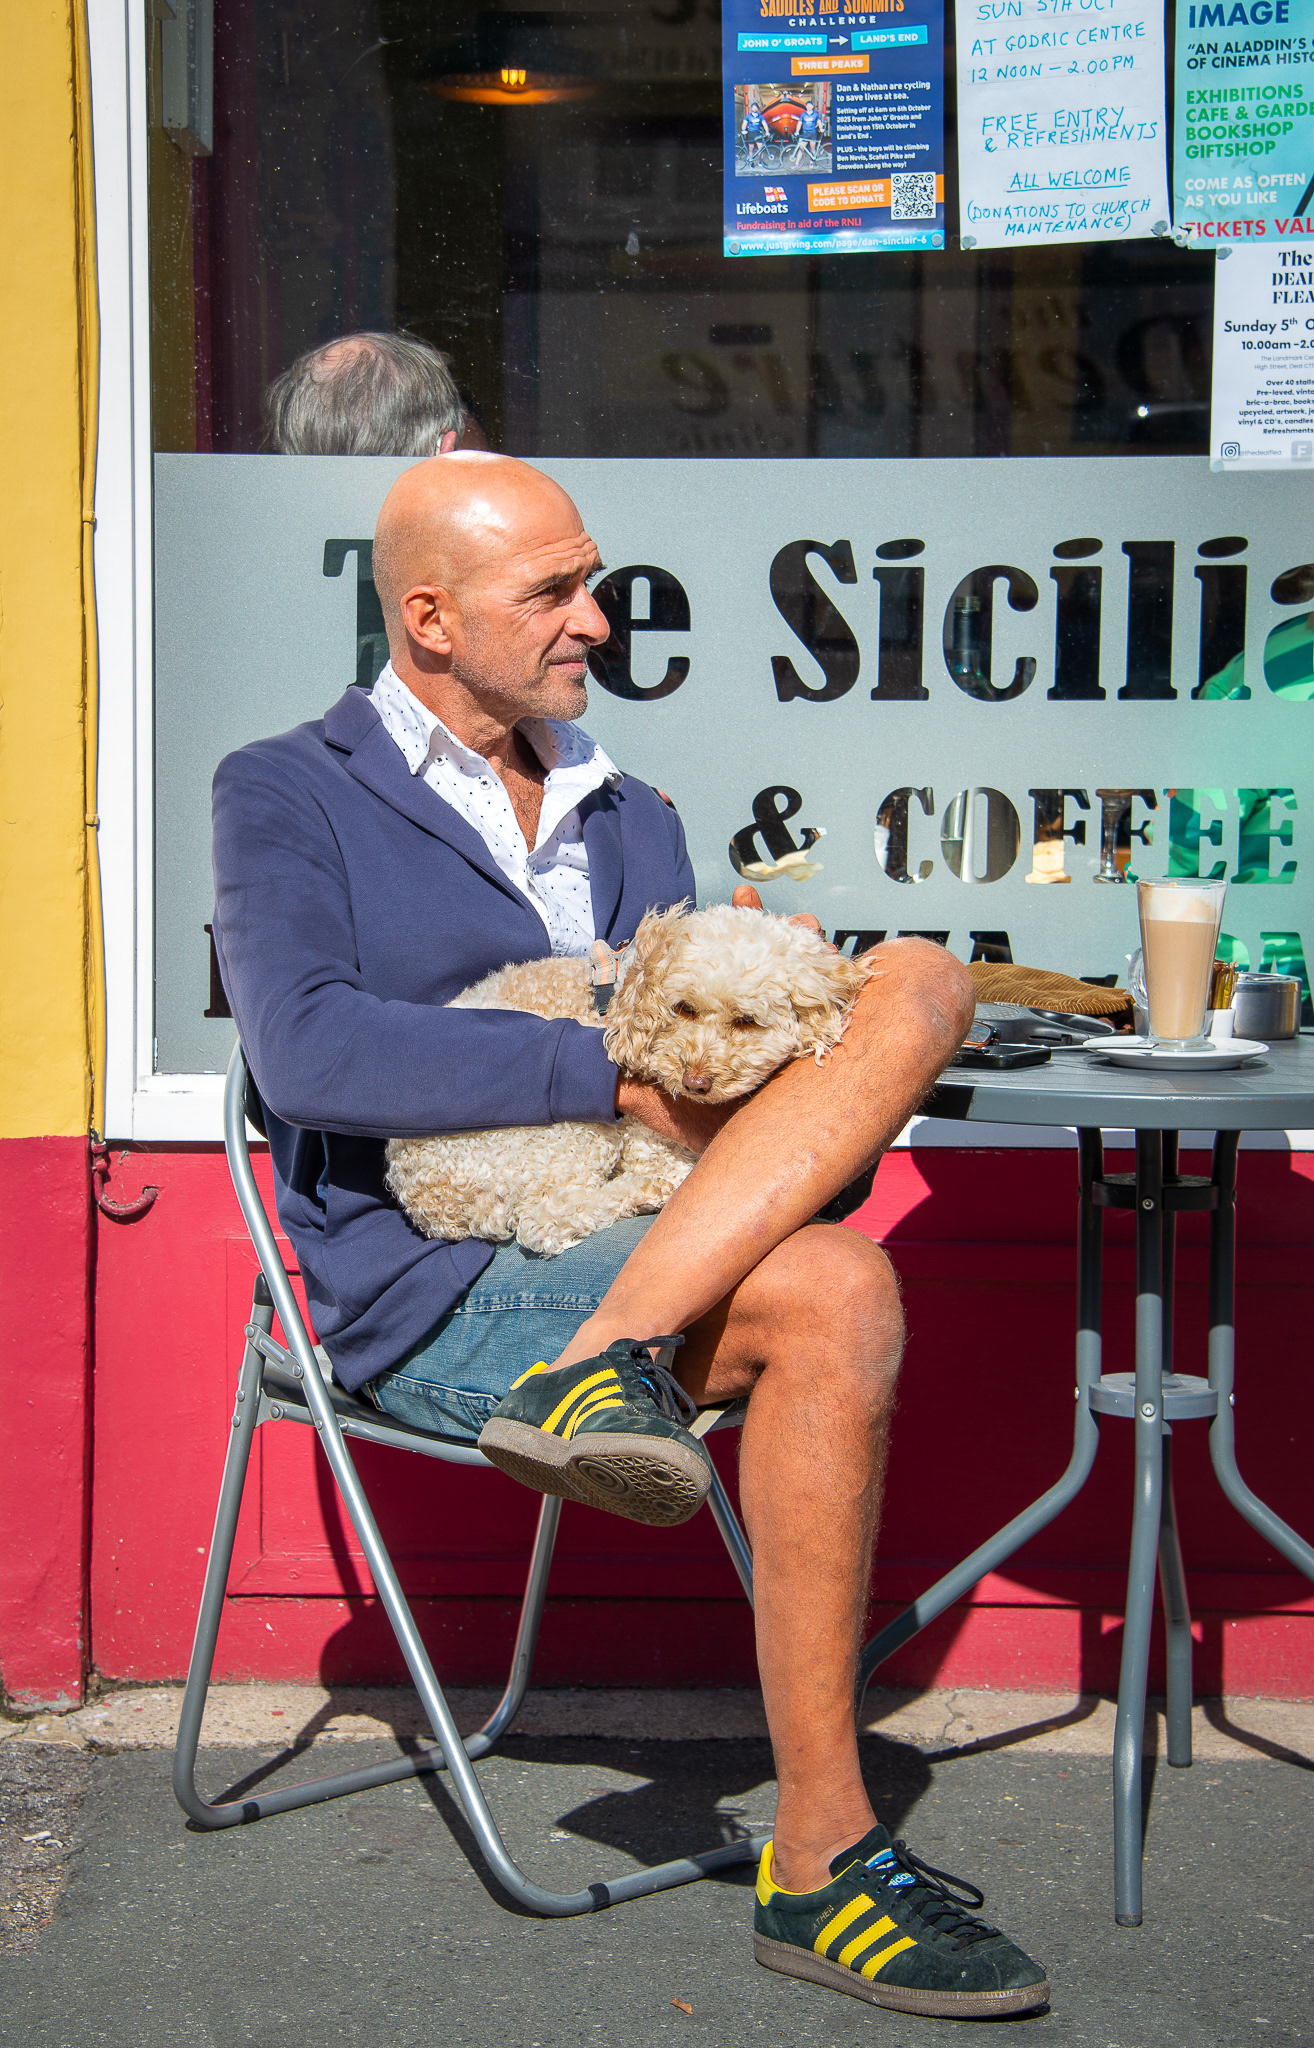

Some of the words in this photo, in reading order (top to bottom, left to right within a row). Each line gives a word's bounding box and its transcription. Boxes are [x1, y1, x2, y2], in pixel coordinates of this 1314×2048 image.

[760, 0, 815, 17] SADDLES
[819, 0, 839, 15] AND
[843, 0, 904, 15] SUMMITS
[977, 0, 1021, 20] SUN
[1189, 0, 1289, 28] IMAGE
[789, 16, 877, 27] CHALLENGE
[742, 39, 769, 48] JOHN
[784, 37, 823, 46] GROATS
[898, 33, 918, 42] END
[972, 39, 997, 56] AT
[1006, 32, 1069, 51] GODRIC
[1077, 22, 1146, 45] CENTRE
[798, 61, 829, 70] THREE
[832, 59, 863, 69] PEAKS
[1187, 58, 1206, 70] OF
[1211, 54, 1271, 69] CINEMA
[972, 68, 987, 83] 12
[997, 64, 1042, 78] NOON
[837, 84, 852, 92] Dan
[861, 83, 888, 92] Nathan
[904, 81, 931, 91] cycling
[1186, 84, 1304, 104] EXHIBITIONS
[837, 94, 845, 102] to
[865, 93, 883, 101] lives
[884, 92, 892, 100] at
[837, 107, 858, 115] Setting
[1186, 107, 1228, 123] CAFE
[1235, 106, 1249, 120] &
[837, 124, 862, 132] finishing
[983, 113, 1038, 135] FREE
[1055, 107, 1124, 128] ENTRY
[1007, 122, 1158, 148] REFRESHMENTS
[1186, 121, 1293, 141] BOOKSHOP
[868, 145, 883, 153] boys
[904, 143, 929, 151] climbing
[1185, 140, 1276, 159] GIFTSHOP
[864, 162, 881, 170] along
[1010, 173, 1039, 188] ALL
[1049, 166, 1131, 187] WELCOME
[1185, 177, 1228, 190] COME
[1233, 177, 1252, 188] AS
[1257, 173, 1306, 187] OFTEN
[813, 186, 845, 196] PLEASE
[847, 185, 870, 194] SCAN
[813, 197, 835, 207] CODE
[837, 196, 849, 205] TO
[850, 194, 884, 204] DONATE
[1184, 195, 1204, 207] AS
[1208, 193, 1241, 206] YOU
[1247, 191, 1277, 204] LIKE
[737, 203, 788, 215] Lifeboats
[1066, 203, 1085, 218] TO
[1092, 199, 1151, 215] CHURCH
[737, 220, 786, 231] Fundraising
[788, 220, 796, 228] in
[798, 219, 811, 228] aid
[813, 218, 823, 227] of
[825, 218, 840, 227] the
[841, 217, 862, 226] RNLI
[1005, 215, 1131, 236] MAINTENANCE)
[740, 235, 926, 251] www.justgiving.com/page/dan-sinclair-6
[1278, 250, 1313, 266] The
[1224, 319, 1277, 335] Sunday
[1281, 317, 1298, 331] 5th
[1242, 341, 1291, 350] 10.00am
[1238, 419, 1256, 427] vinyl
[323, 539, 691, 700] Te
[728, 785, 827, 882] &
[873, 787, 1298, 884] COFFEE
